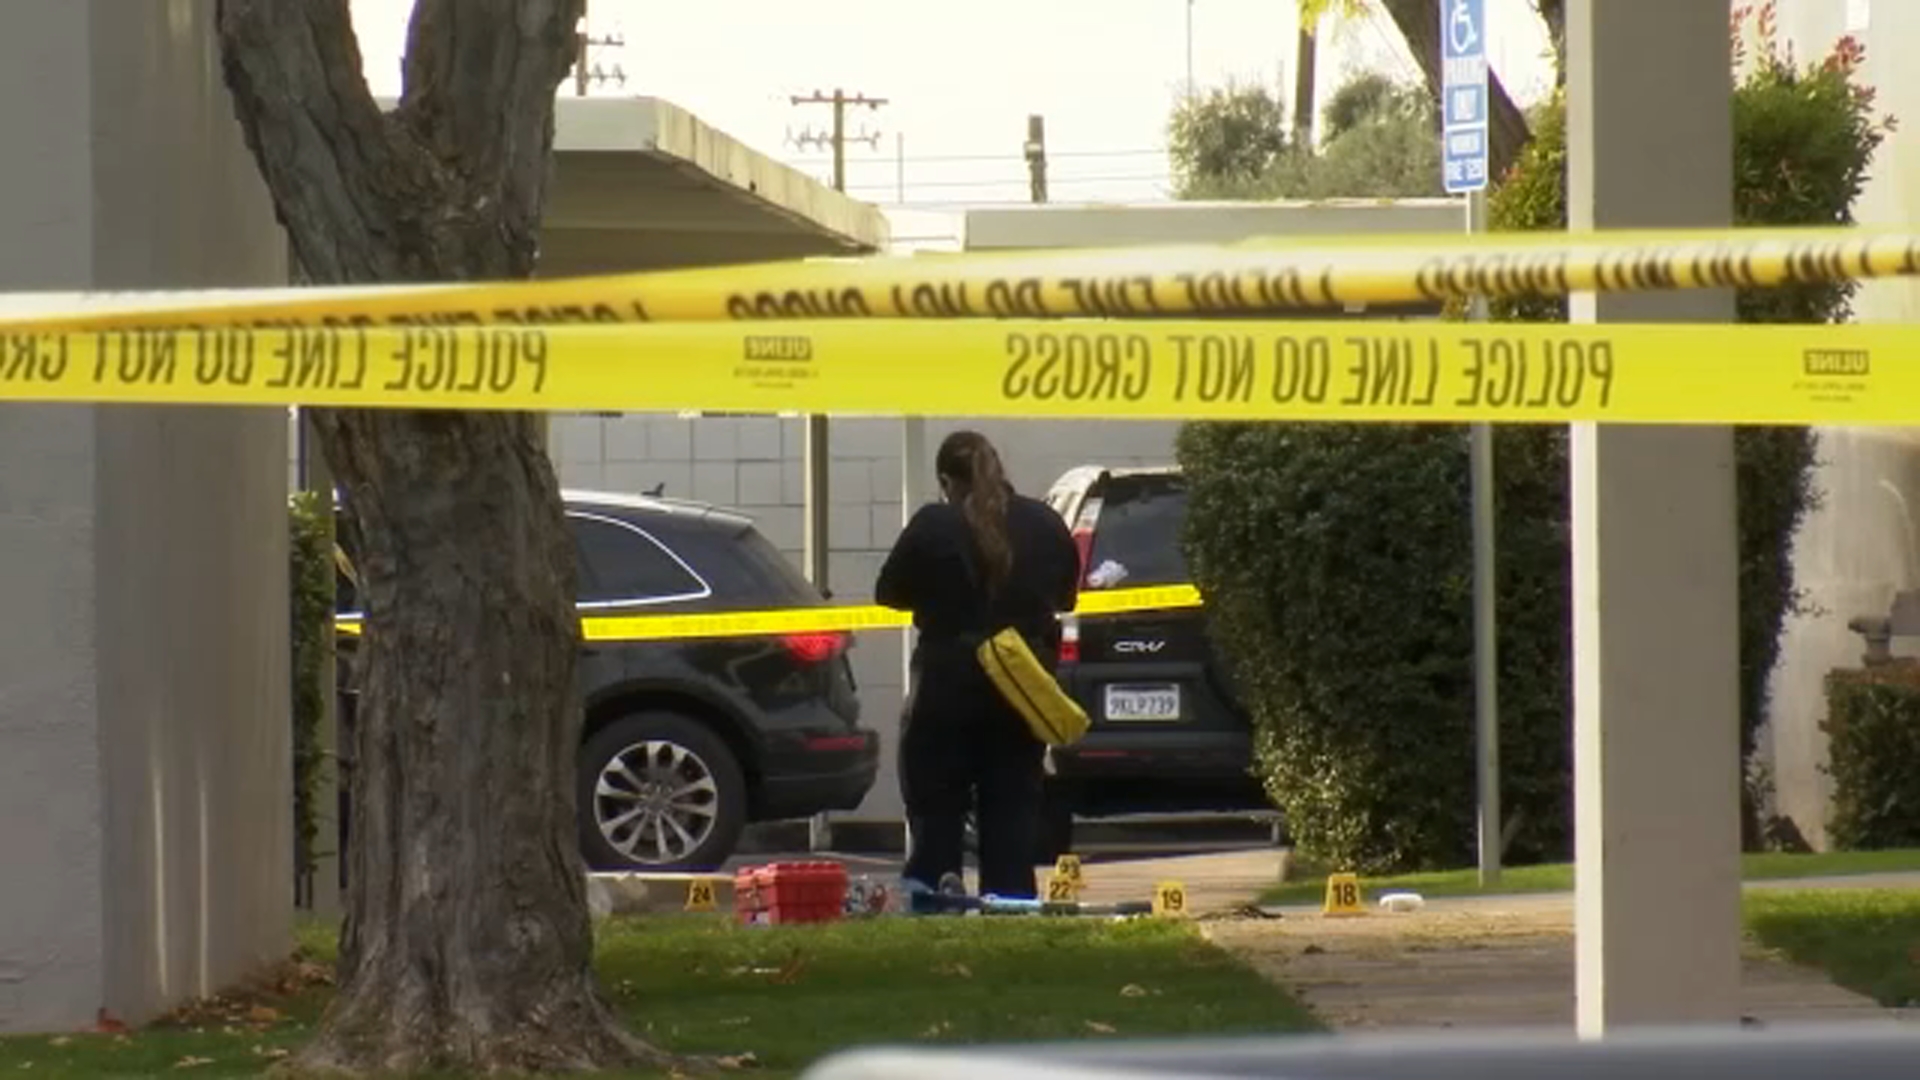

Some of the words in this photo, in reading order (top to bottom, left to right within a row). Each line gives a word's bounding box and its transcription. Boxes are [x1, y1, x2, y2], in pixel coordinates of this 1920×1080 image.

[693, 886, 711, 904] 24
[1049, 880, 1071, 900] 22
[1161, 889, 1183, 910] 19
[1332, 882, 1358, 907] 18
